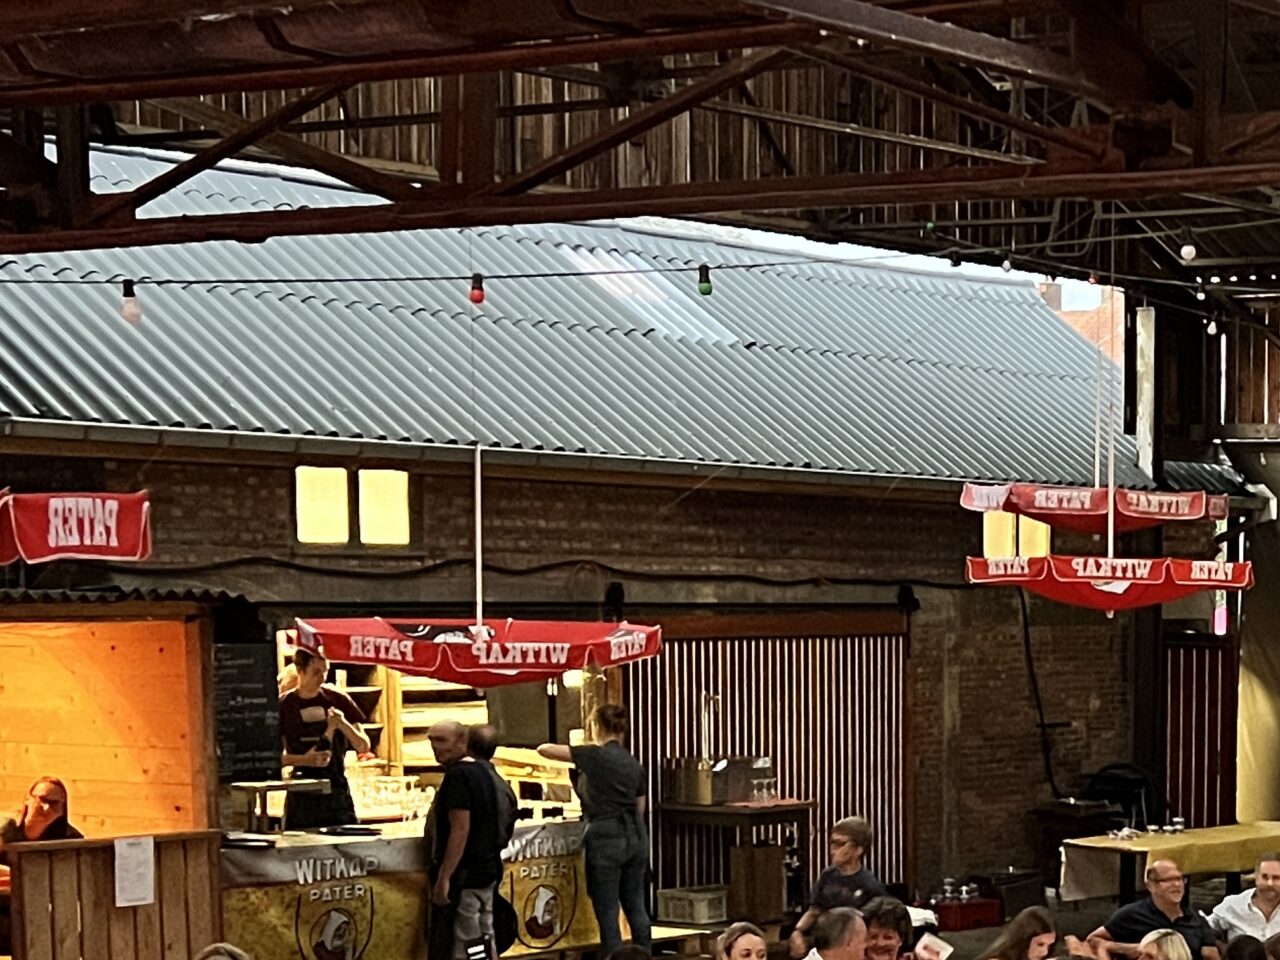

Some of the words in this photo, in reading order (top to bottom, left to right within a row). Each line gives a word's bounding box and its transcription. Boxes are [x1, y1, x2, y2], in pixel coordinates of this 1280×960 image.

[507, 836, 580, 862] WITKAP
[295, 856, 379, 885] WITKAP
[520, 863, 568, 879] PATER
[310, 884, 367, 902] PATER
